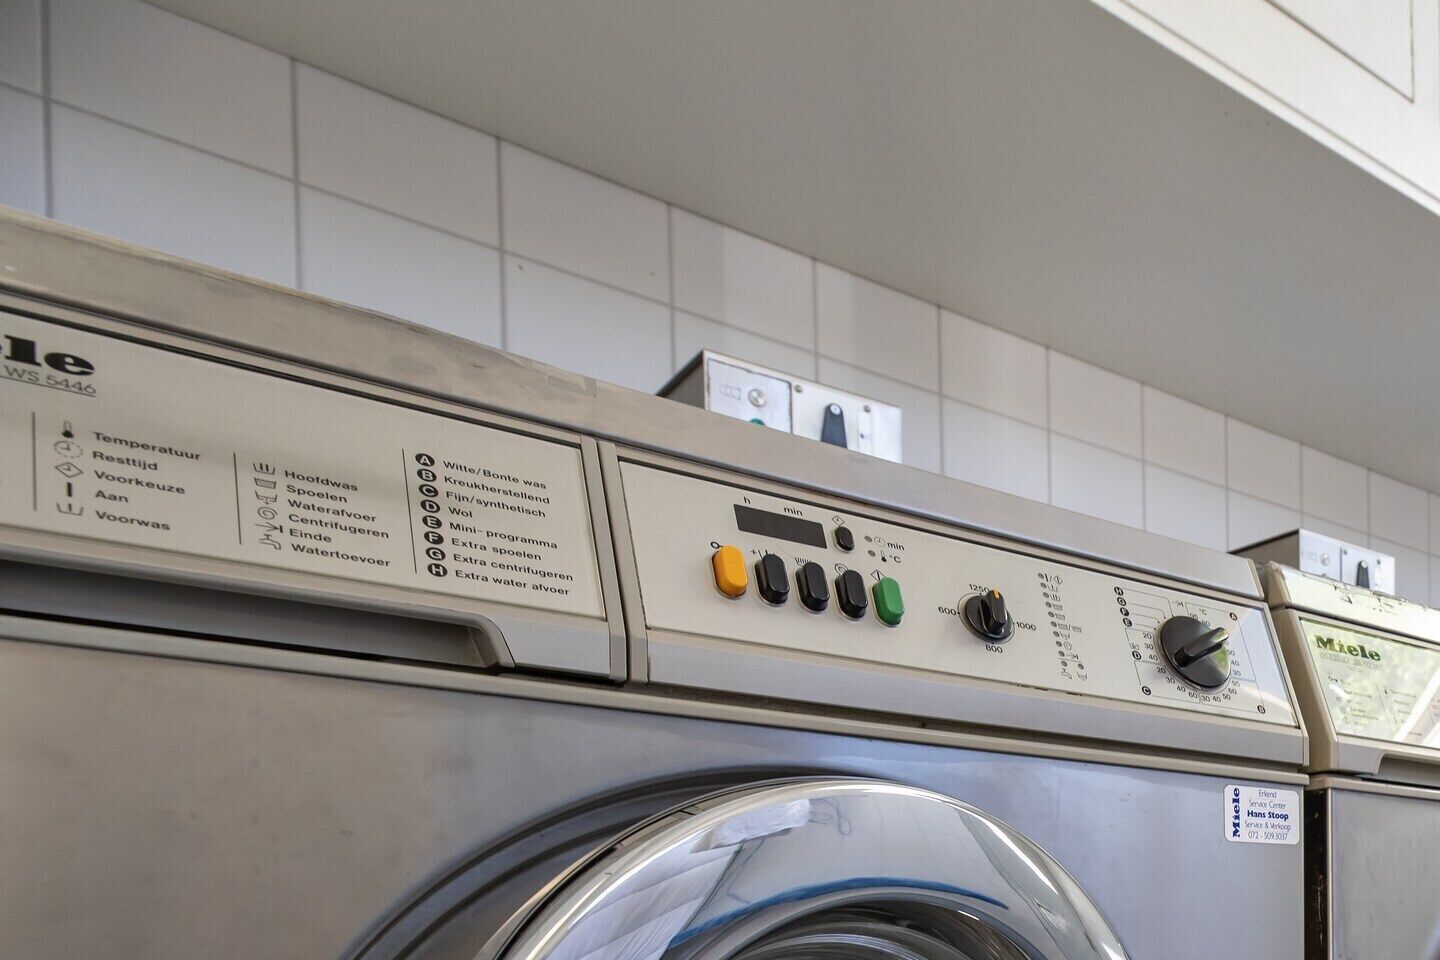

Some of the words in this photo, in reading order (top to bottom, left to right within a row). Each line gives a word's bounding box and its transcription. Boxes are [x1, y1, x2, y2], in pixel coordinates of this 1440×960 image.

[0, 335, 95, 376] le
[4, 365, 40, 383] WS
[46, 374, 97, 394] 5446
[92, 431, 202, 461] Temperatuur
[92, 450, 158, 471] Resttijd
[417, 454, 433, 467] A
[442, 460, 519, 484] Witte/Bonte
[522, 479, 547, 489] was
[94, 470, 186, 494] Voorkeuze
[284, 469, 359, 492] Hoofdwas
[419, 469, 435, 482] B
[444, 475, 550, 505] Kreukherstellend
[94, 490, 129, 503] Aan
[286, 484, 348, 503] Spoelen
[743, 495, 751, 505] h
[421, 485, 436, 498] C
[445, 490, 546, 518] Fijn/synthetisch
[287, 498, 377, 523] Waterafvoer
[423, 500, 438, 513] D
[448, 506, 473, 518] Wol
[783, 506, 803, 516] min
[95, 510, 171, 531] Voorwas
[288, 514, 390, 539] Centrifugeren
[424, 516, 440, 528] E
[289, 528, 332, 543] Einde
[426, 532, 442, 544] F
[451, 537, 487, 551] Extra
[492, 545, 542, 561] spoelen
[886, 541, 905, 551] min
[291, 543, 391, 567] Watertoevoer
[428, 548, 443, 560] G
[453, 553, 487, 567] Extra
[490, 560, 573, 581] centrifugeren
[430, 564, 445, 577] H
[455, 569, 489, 582] Extra
[492, 576, 528, 589] water
[531, 582, 570, 596] afvoer
[968, 583, 990, 593] 1250
[938, 606, 957, 616] 600
[1016, 621, 1037, 631] 1000
[1142, 632, 1152, 640] 20
[985, 643, 1003, 654] 800
[1144, 642, 1154, 650] 30
[1314, 634, 1381, 661] Miele
[1156, 666, 1166, 674] 20
[1232, 669, 1242, 677] 30
[1165, 676, 1176, 684] 30
[1176, 685, 1186, 693] 40
[1188, 691, 1198, 699] 60
[1201, 694, 1211, 702] 30
[1212, 695, 1222, 703] 40
[1259, 789, 1277, 798] Erkend
[1249, 799, 1267, 808] Service
[1268, 800, 1287, 810] Center
[1232, 787, 1240, 838] Miele
[1247, 810, 1266, 818] Hans
[1267, 811, 1289, 822] Stoop
[1245, 820, 1263, 829] Service
[1270, 821, 1291, 832] Verkoop
